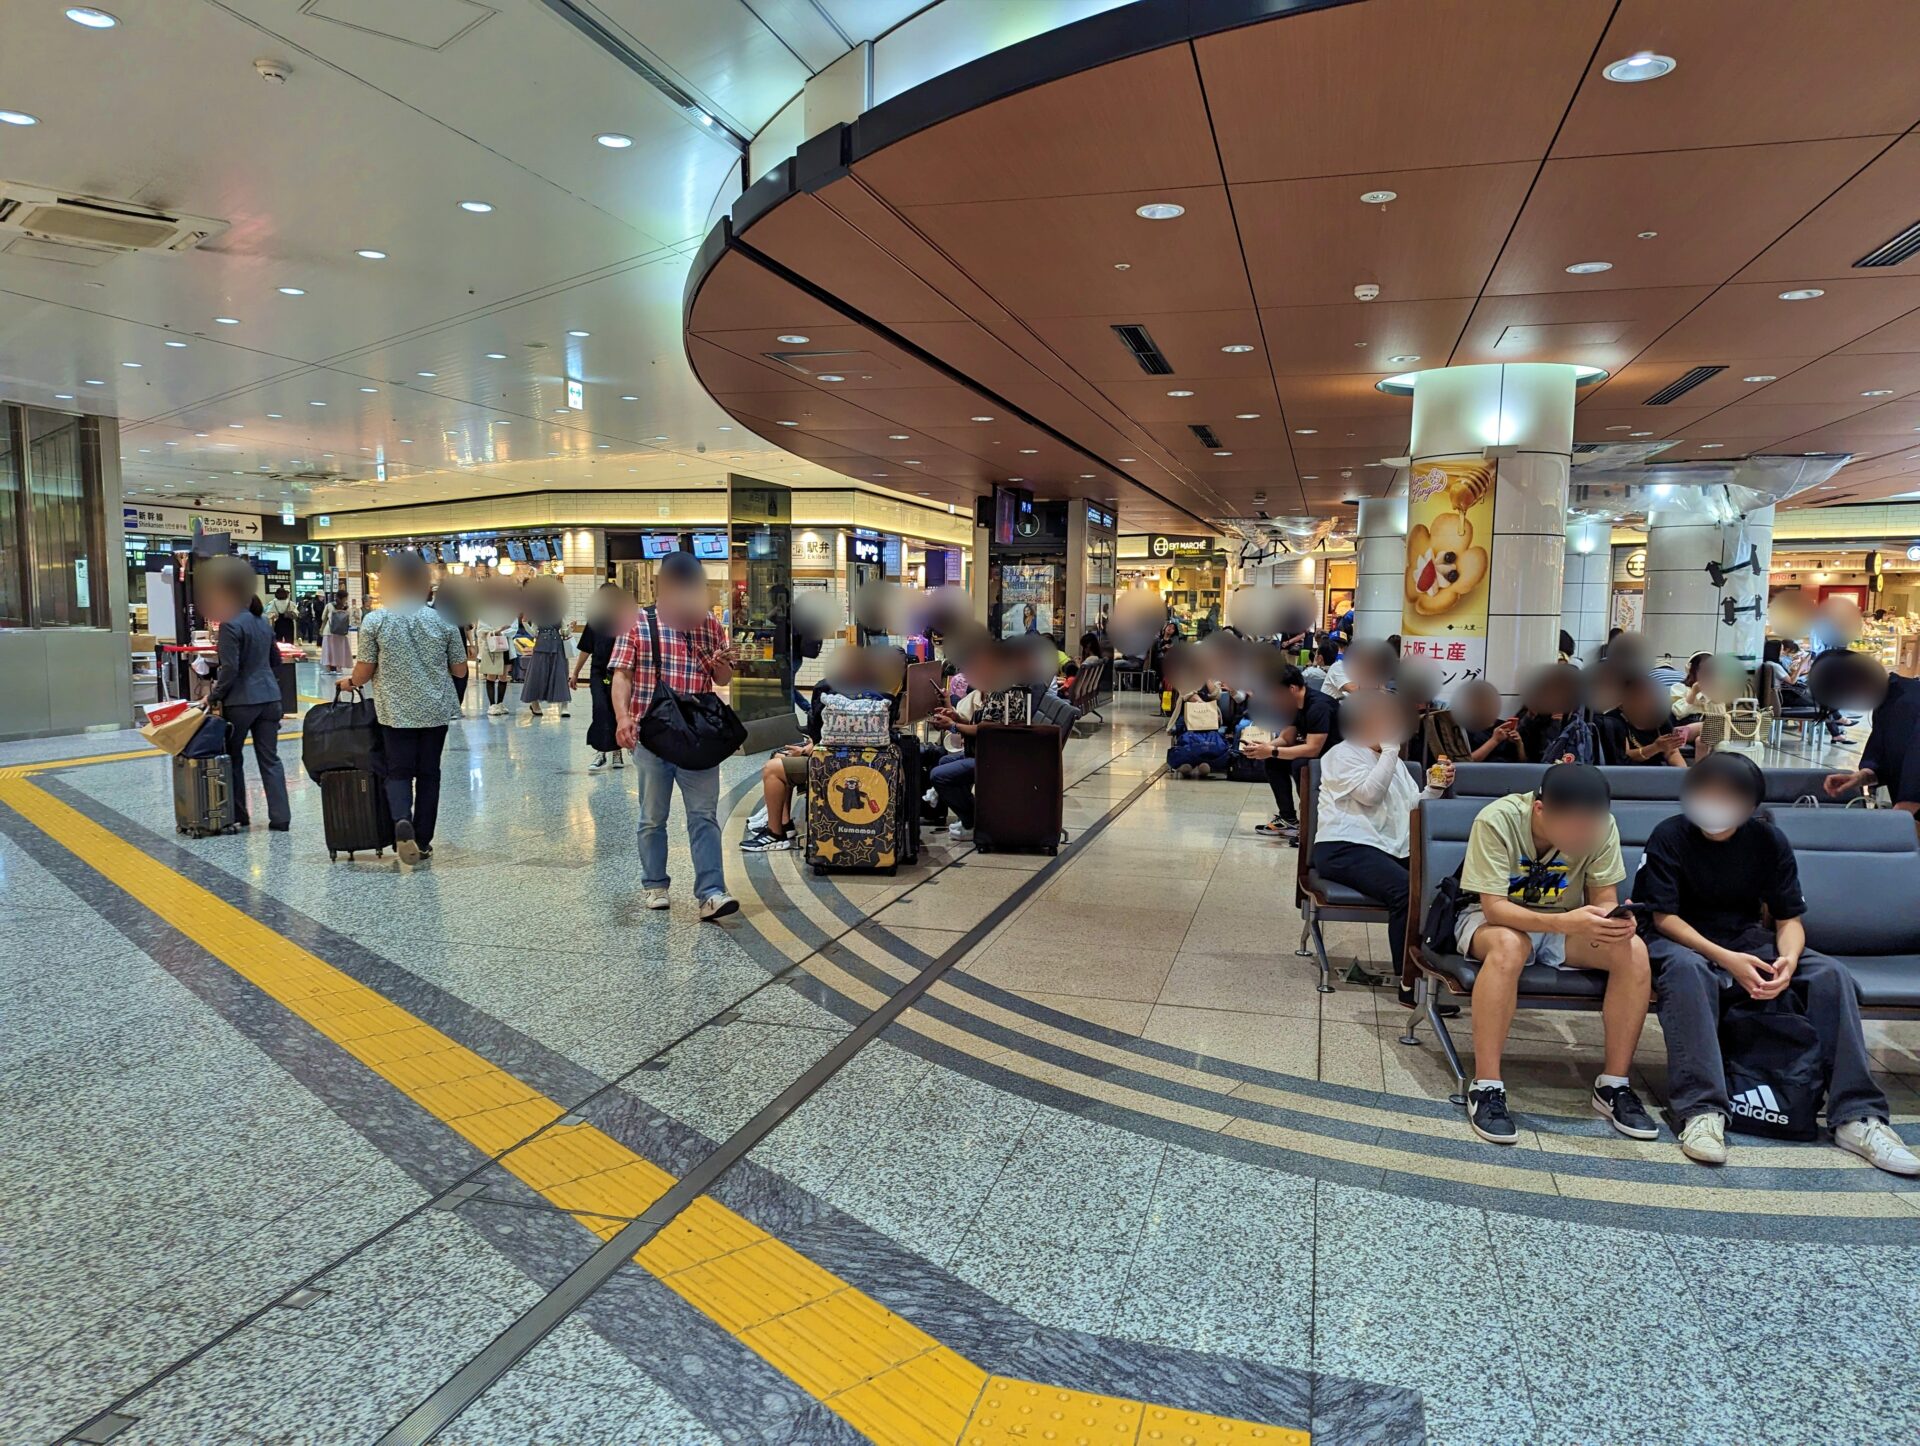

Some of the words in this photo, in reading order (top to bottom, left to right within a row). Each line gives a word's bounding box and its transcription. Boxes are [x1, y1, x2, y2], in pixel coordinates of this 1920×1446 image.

[204, 517, 240, 527] きっぷうりば
[807, 541, 830, 554] 駅弁
[1403, 641, 1467, 661] 大阪土産
[838, 826, 876, 835] Kumamon
[1729, 1100, 1789, 1125] adidas
